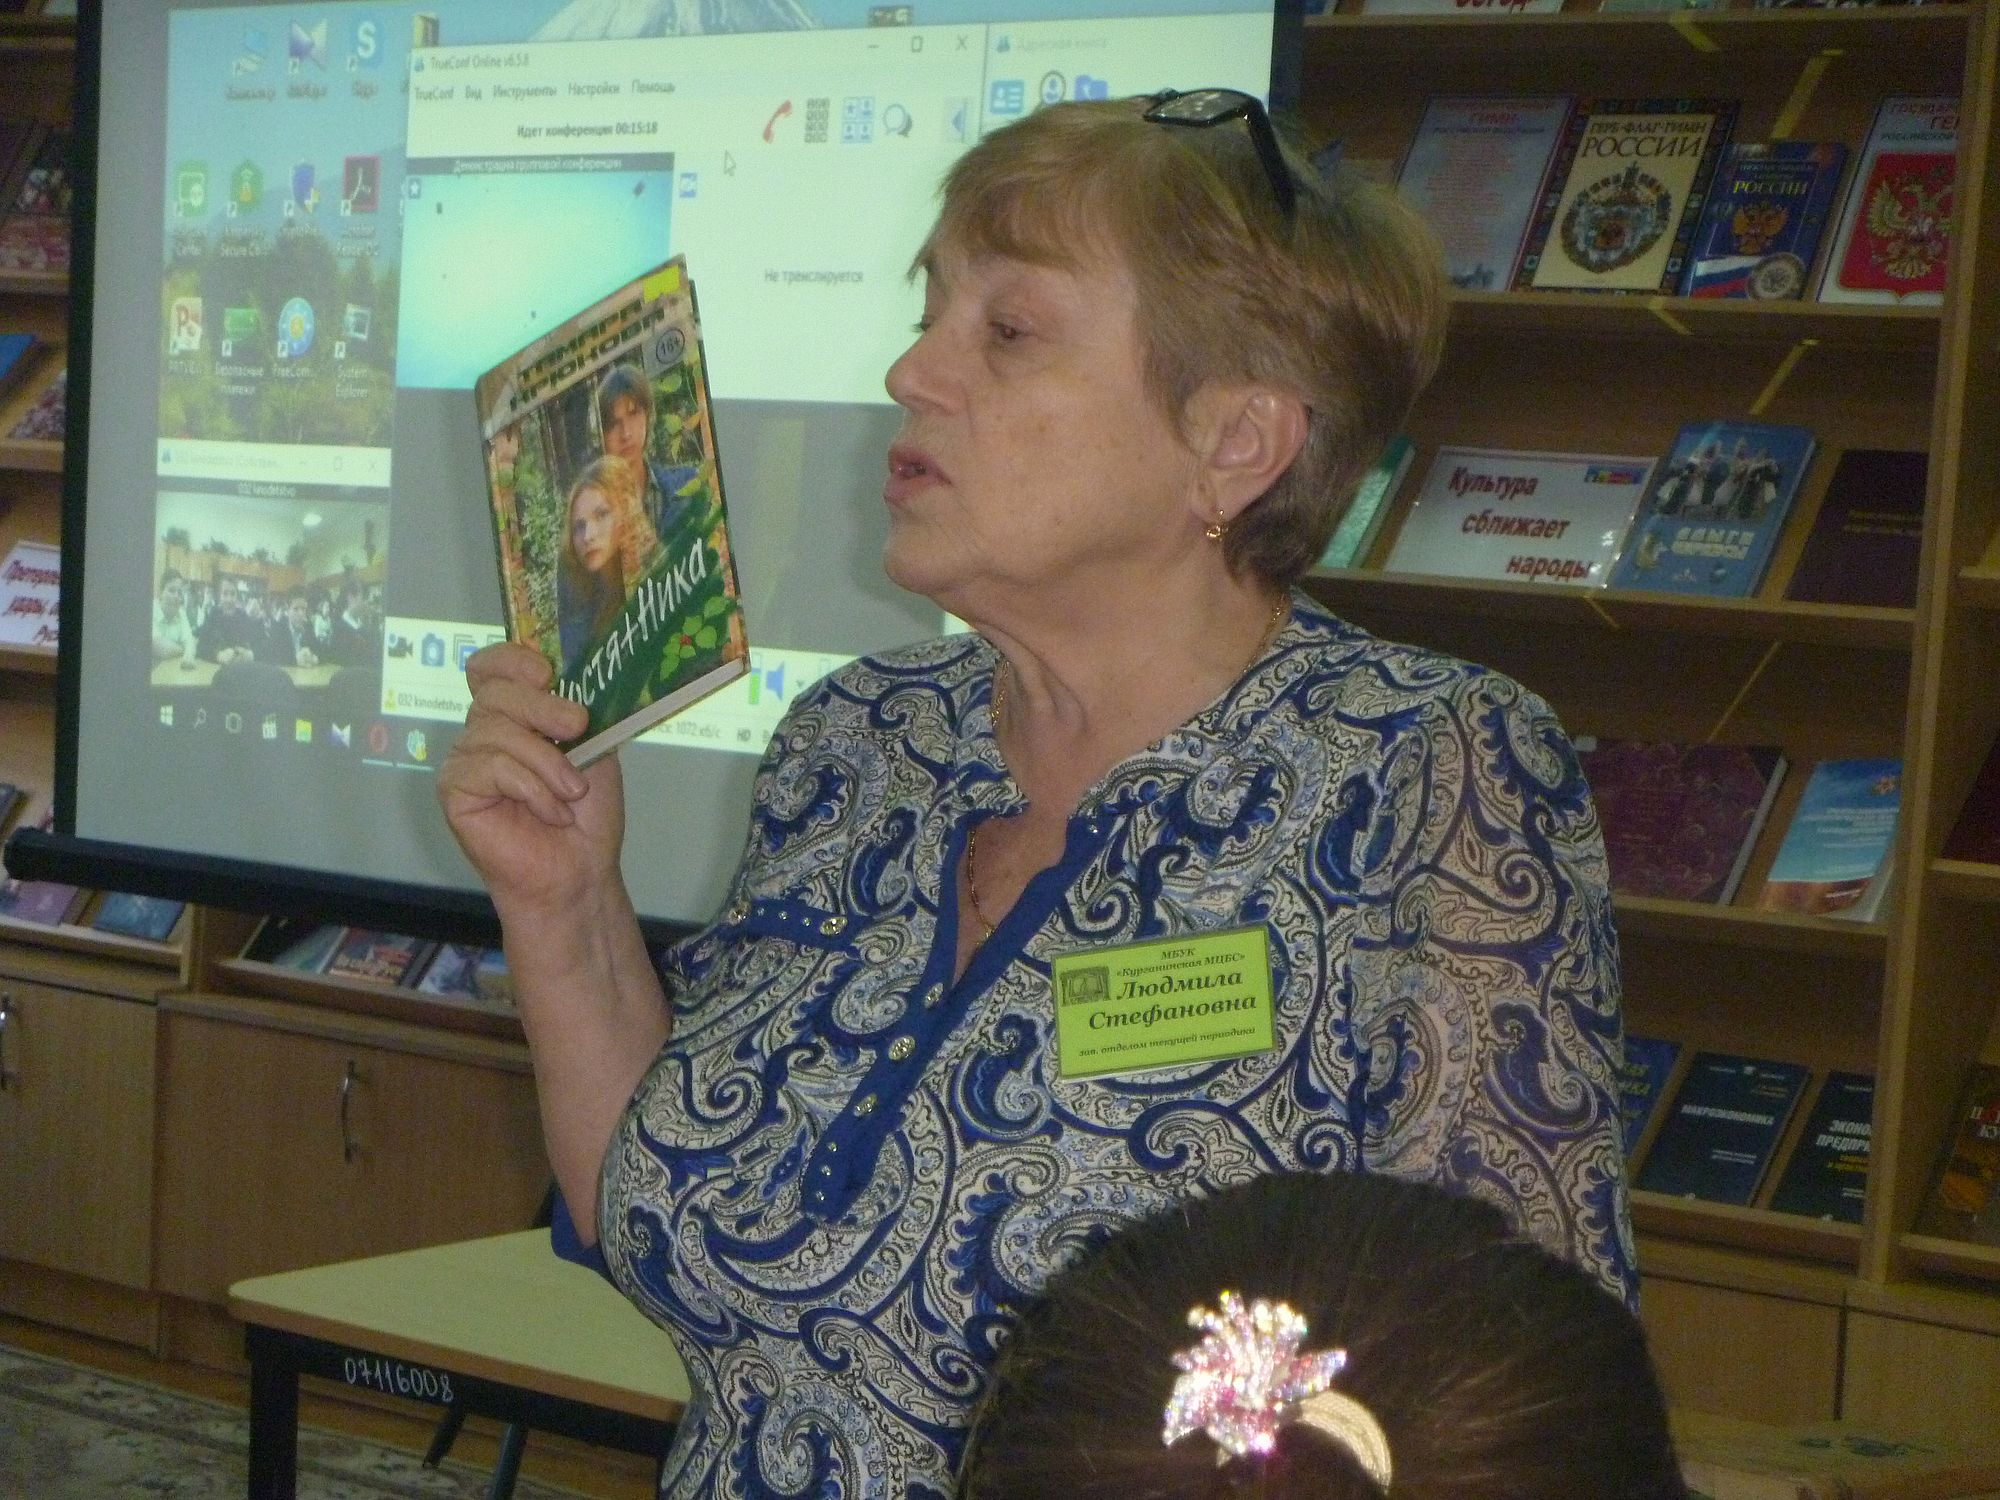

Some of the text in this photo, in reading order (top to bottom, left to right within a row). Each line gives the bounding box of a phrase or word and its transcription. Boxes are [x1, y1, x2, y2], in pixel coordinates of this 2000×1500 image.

[431, 56, 470, 70] TrueConf
[472, 55, 501, 68] Online
[415, 79, 675, 101] TrueConf Вид Инструменты Настройки Помощь
[517, 122, 658, 138] Идет конференция 00:15:18
[1581, 136, 1702, 158] РОССИИ
[1733, 181, 1809, 194] РОССИИ
[764, 268, 864, 286] Не транслируется
[1449, 466, 1539, 501] Культура
[1462, 508, 1571, 540] сближает
[1506, 555, 1594, 583] народы
[1160, 947, 1196, 961] МБУК
[1205, 952, 1246, 967] МЦБС»
[1116, 970, 1243, 1000] Людмила
[1089, 994, 1257, 1031] Стефановна
[1078, 1026, 1256, 1058] зав. отделом текущей периодики
[344, 1356, 455, 1403] 07116008
